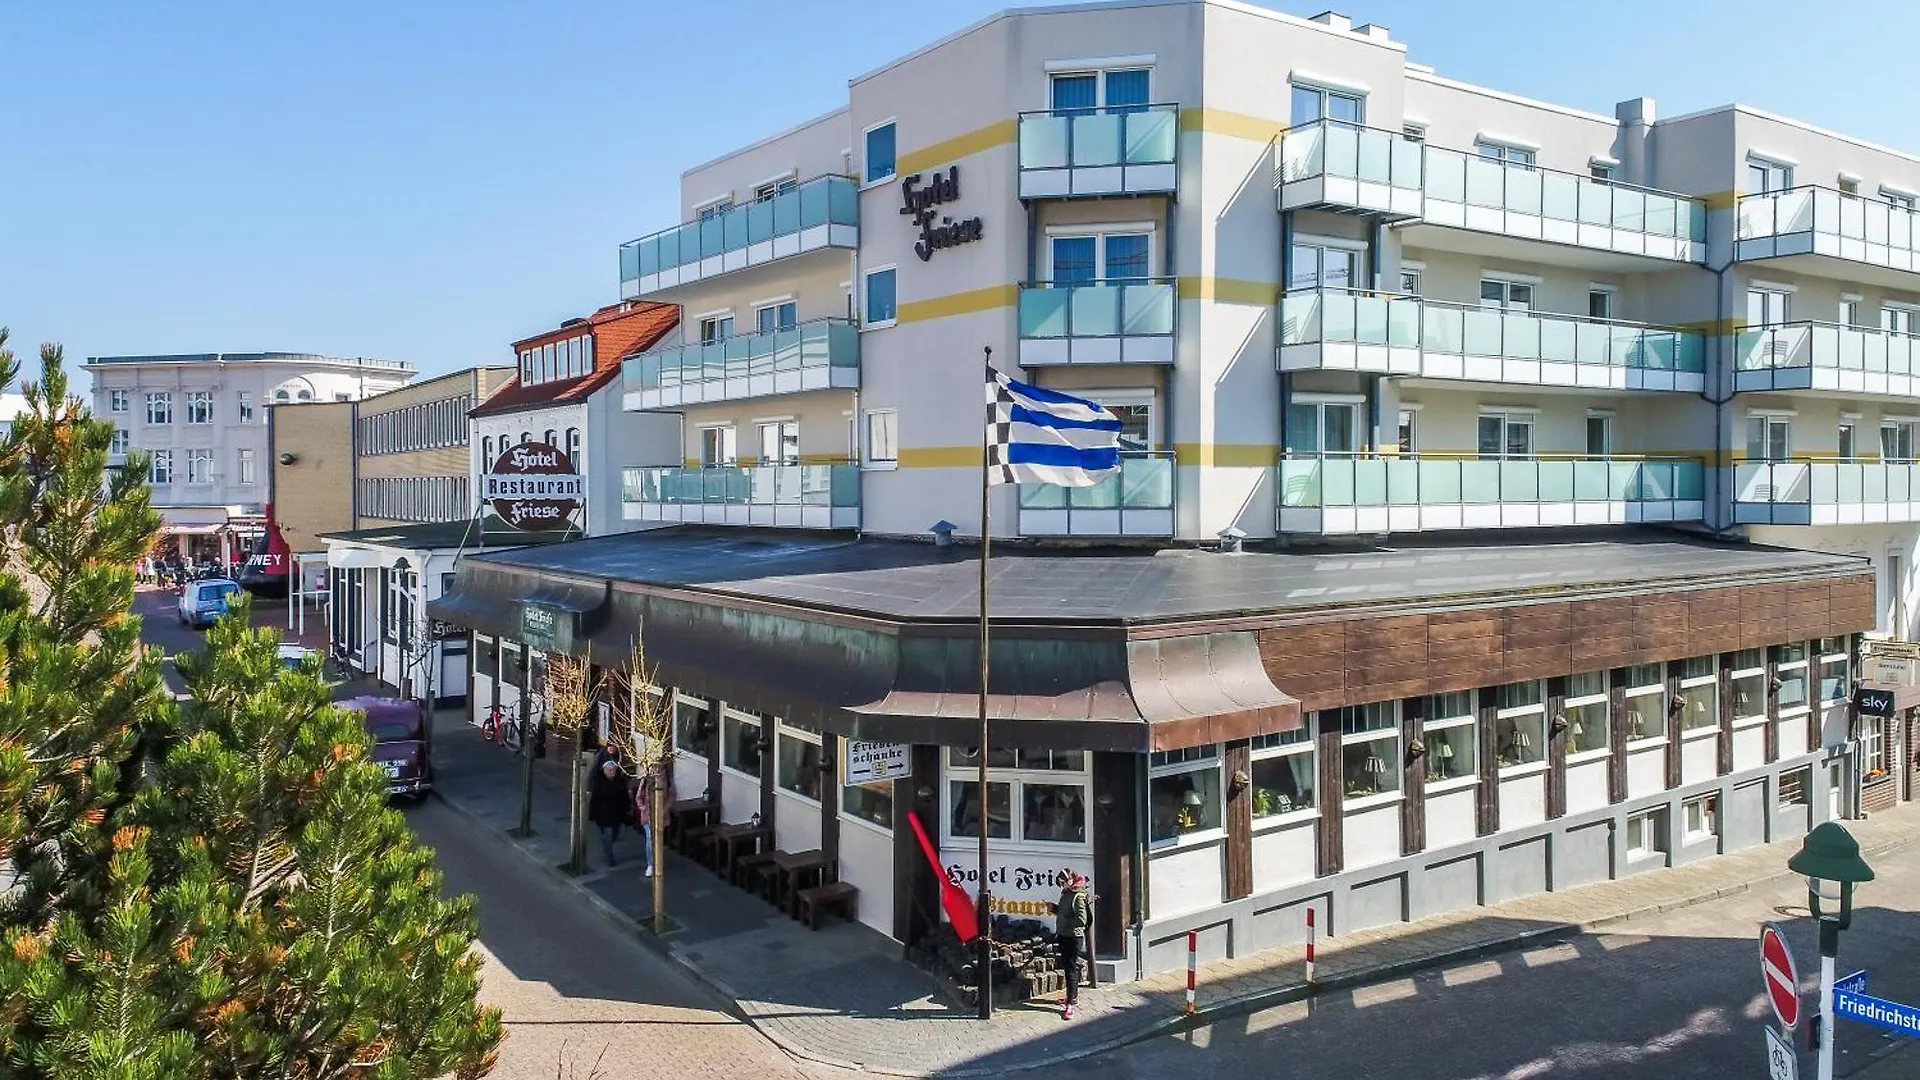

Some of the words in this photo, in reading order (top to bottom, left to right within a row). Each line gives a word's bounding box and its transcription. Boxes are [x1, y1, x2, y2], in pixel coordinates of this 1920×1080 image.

[900, 165, 959, 225] Hotel
[914, 209, 983, 261] Friese
[510, 447, 558, 471] Hotel
[488, 478, 582, 495] Restaurant
[510, 501, 560, 525] Friese
[1862, 695, 1888, 711] sky
[946, 864, 1005, 887] Hoel
